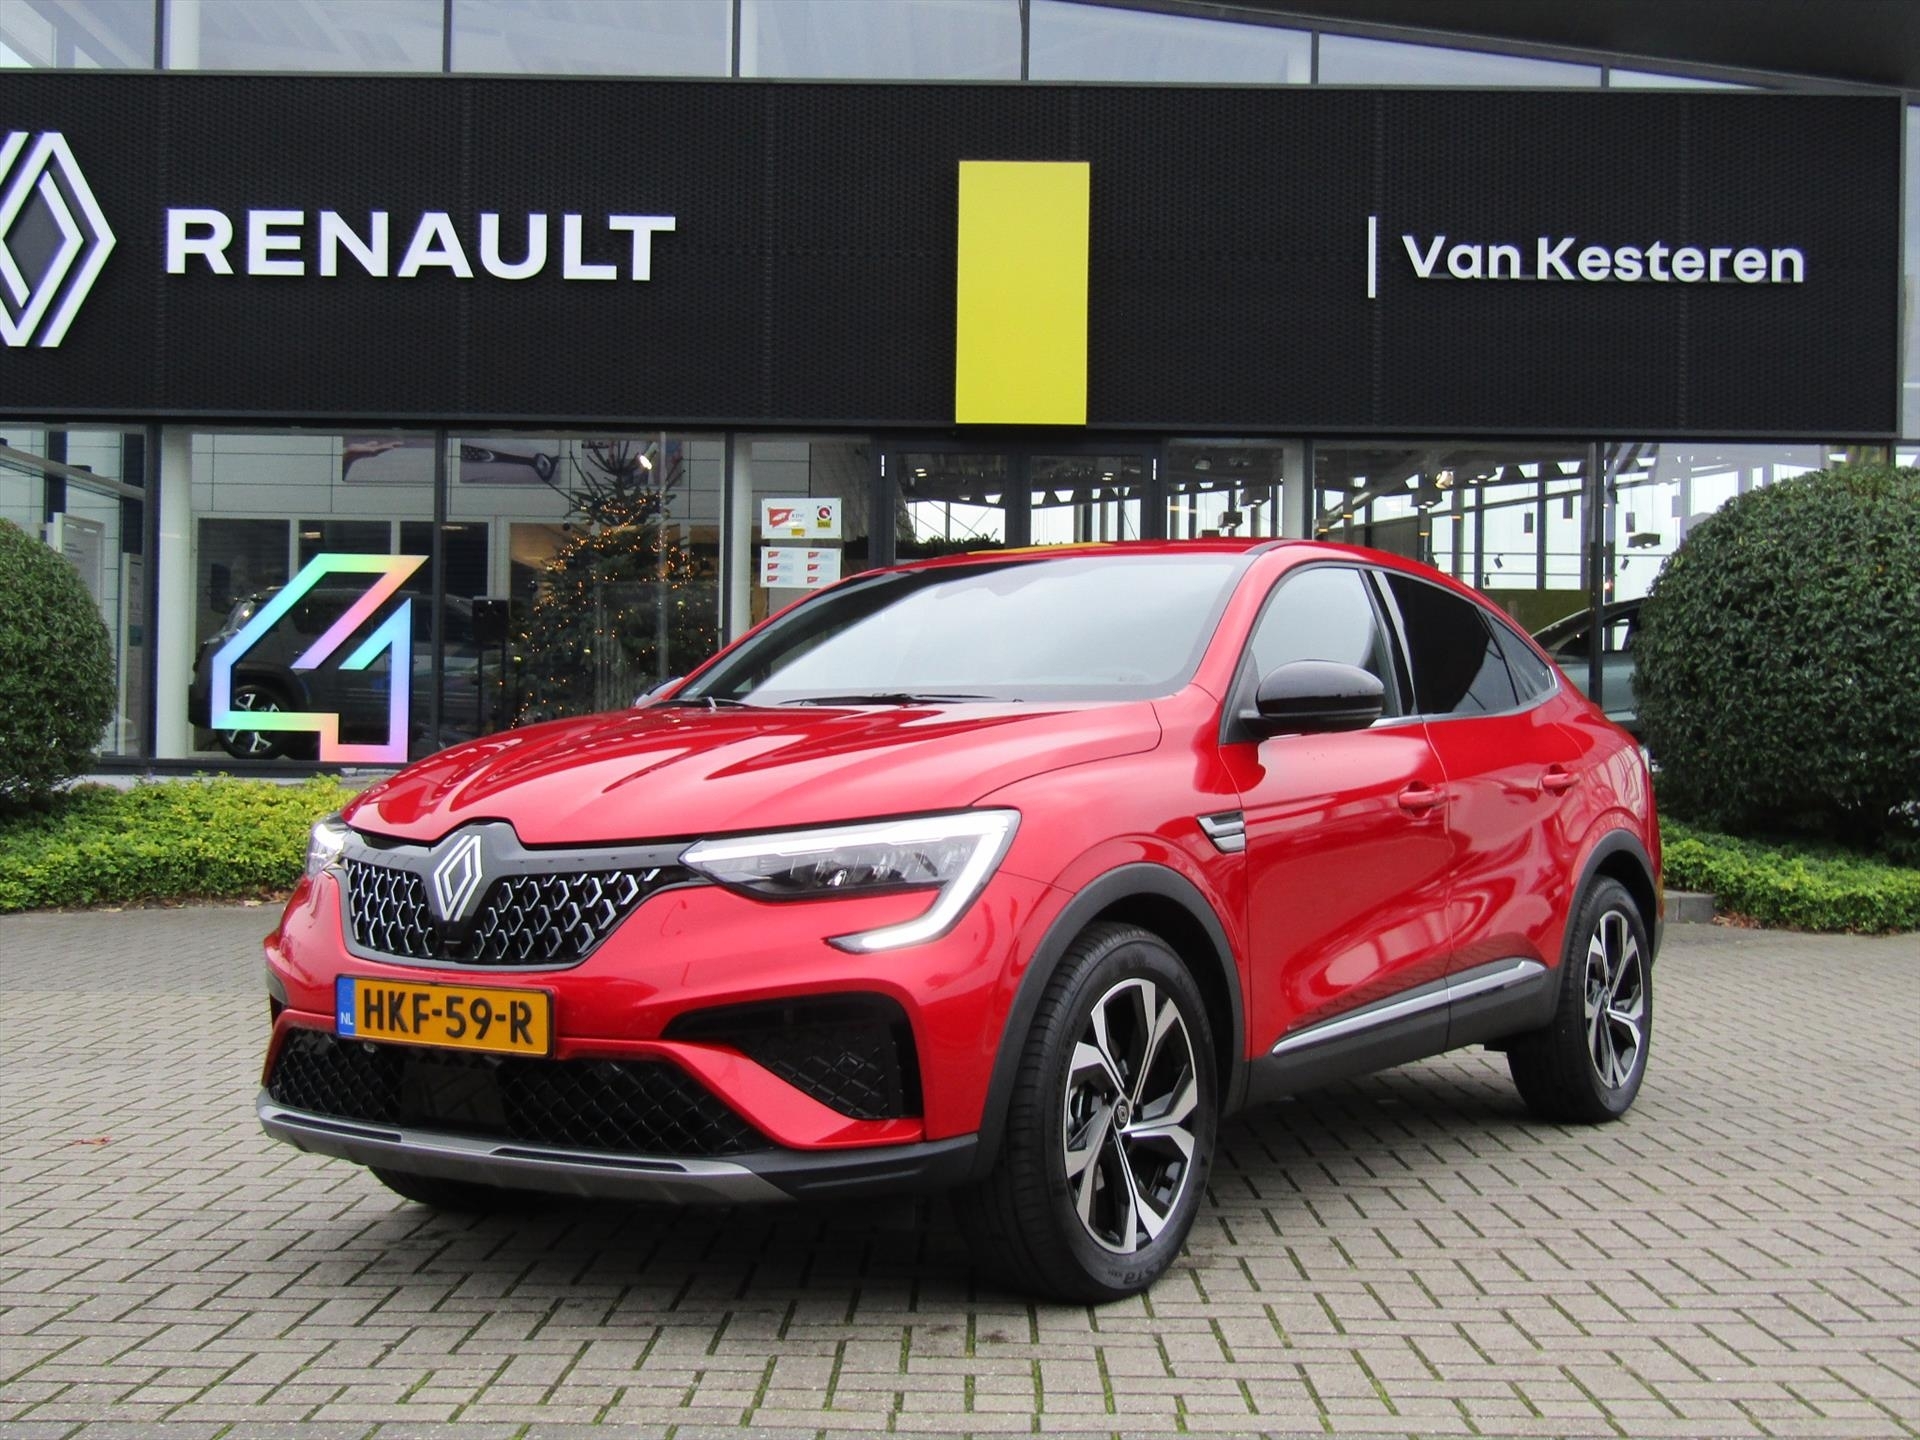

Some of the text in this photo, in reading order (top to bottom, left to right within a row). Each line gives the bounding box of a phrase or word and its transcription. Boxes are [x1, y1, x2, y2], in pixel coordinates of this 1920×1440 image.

[166, 208, 676, 281] RENAULT
[1401, 235, 1805, 283] Van Kesteren
[340, 1011, 354, 1026] NL
[363, 988, 533, 1045] HKF-59-R
